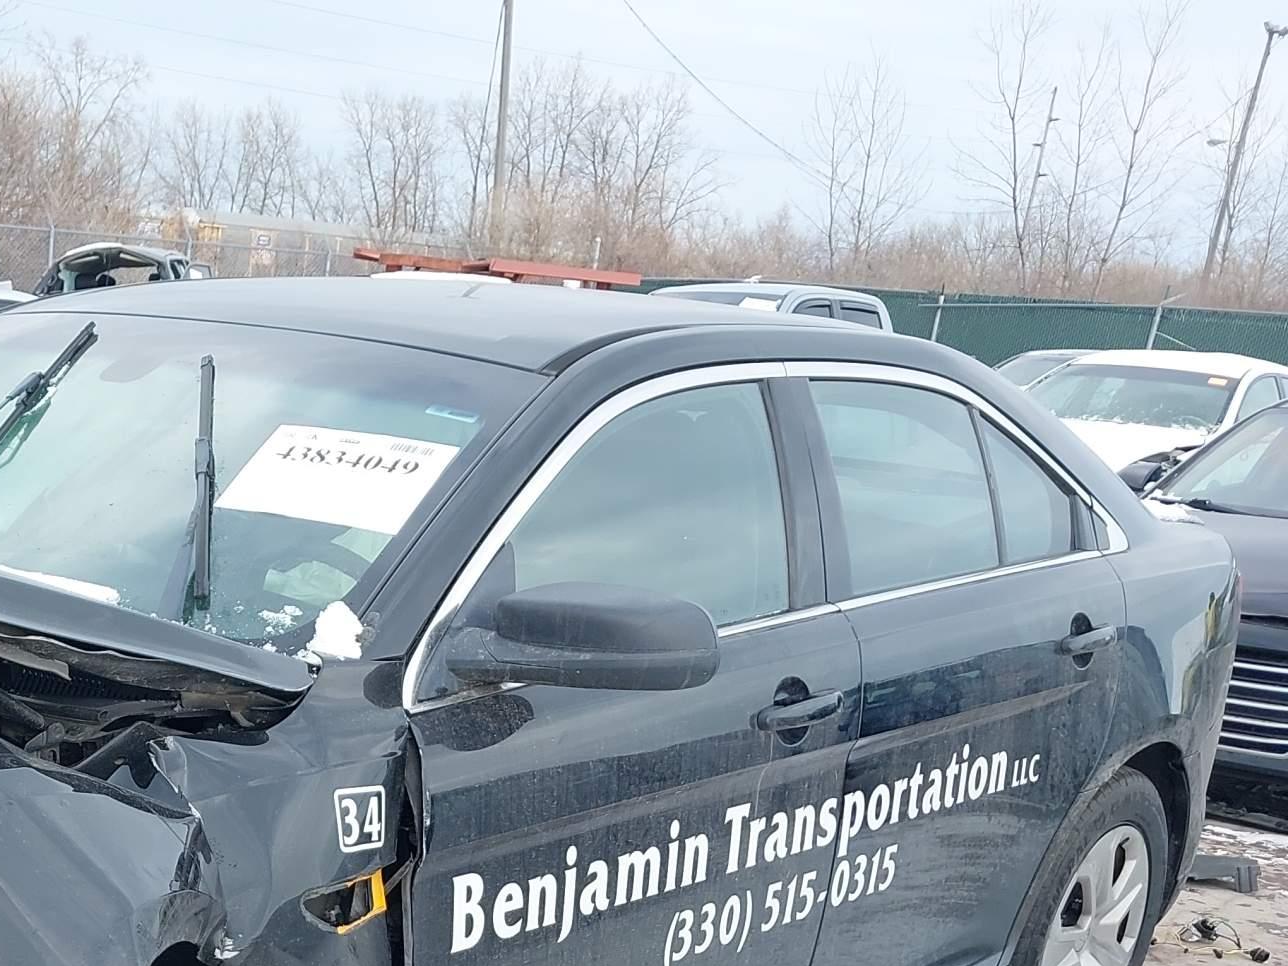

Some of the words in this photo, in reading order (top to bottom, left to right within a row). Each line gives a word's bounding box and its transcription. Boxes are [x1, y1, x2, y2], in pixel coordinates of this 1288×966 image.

[275, 444, 421, 475] 43834049
[340, 796, 383, 846] 34
[450, 818, 710, 954] Benjamin
[723, 742, 1009, 875] Transportation
[1011, 753, 1041, 789] LLC
[760, 843, 900, 934] 515-0315
